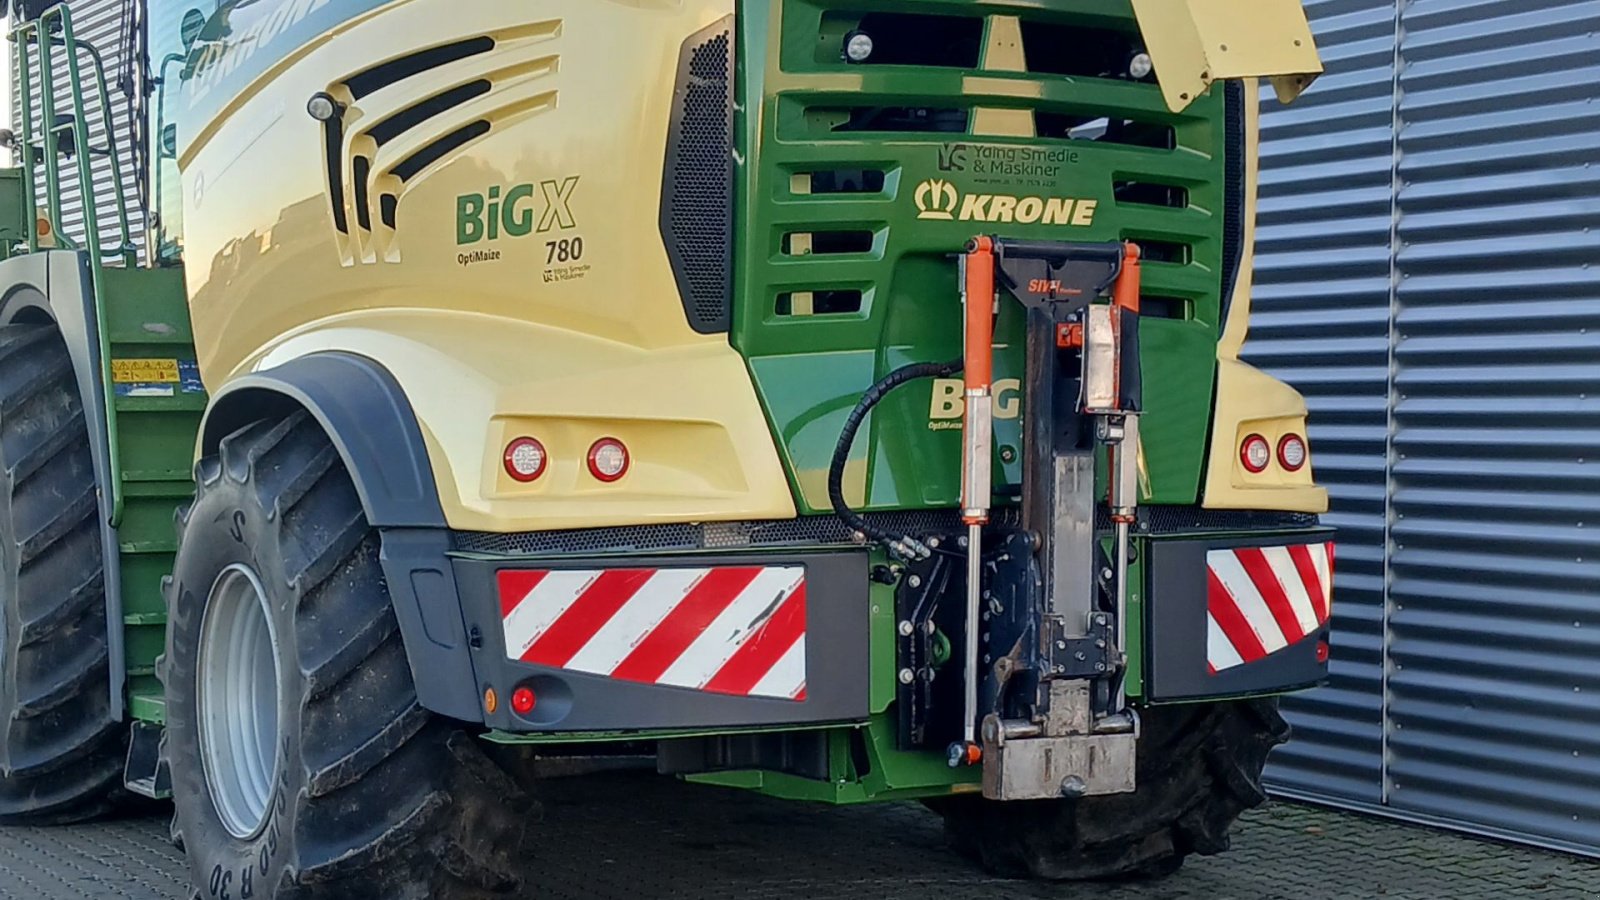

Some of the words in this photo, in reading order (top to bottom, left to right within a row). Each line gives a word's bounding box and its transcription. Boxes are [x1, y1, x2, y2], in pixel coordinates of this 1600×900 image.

[1021, 148, 1079, 163] Smedie
[974, 160, 985, 173] &
[990, 161, 1061, 177] Maskiner
[958, 194, 1097, 226] KRONE
[458, 249, 500, 266] OptiMaize
[545, 237, 583, 264] 780
[929, 378, 1020, 419] BG
